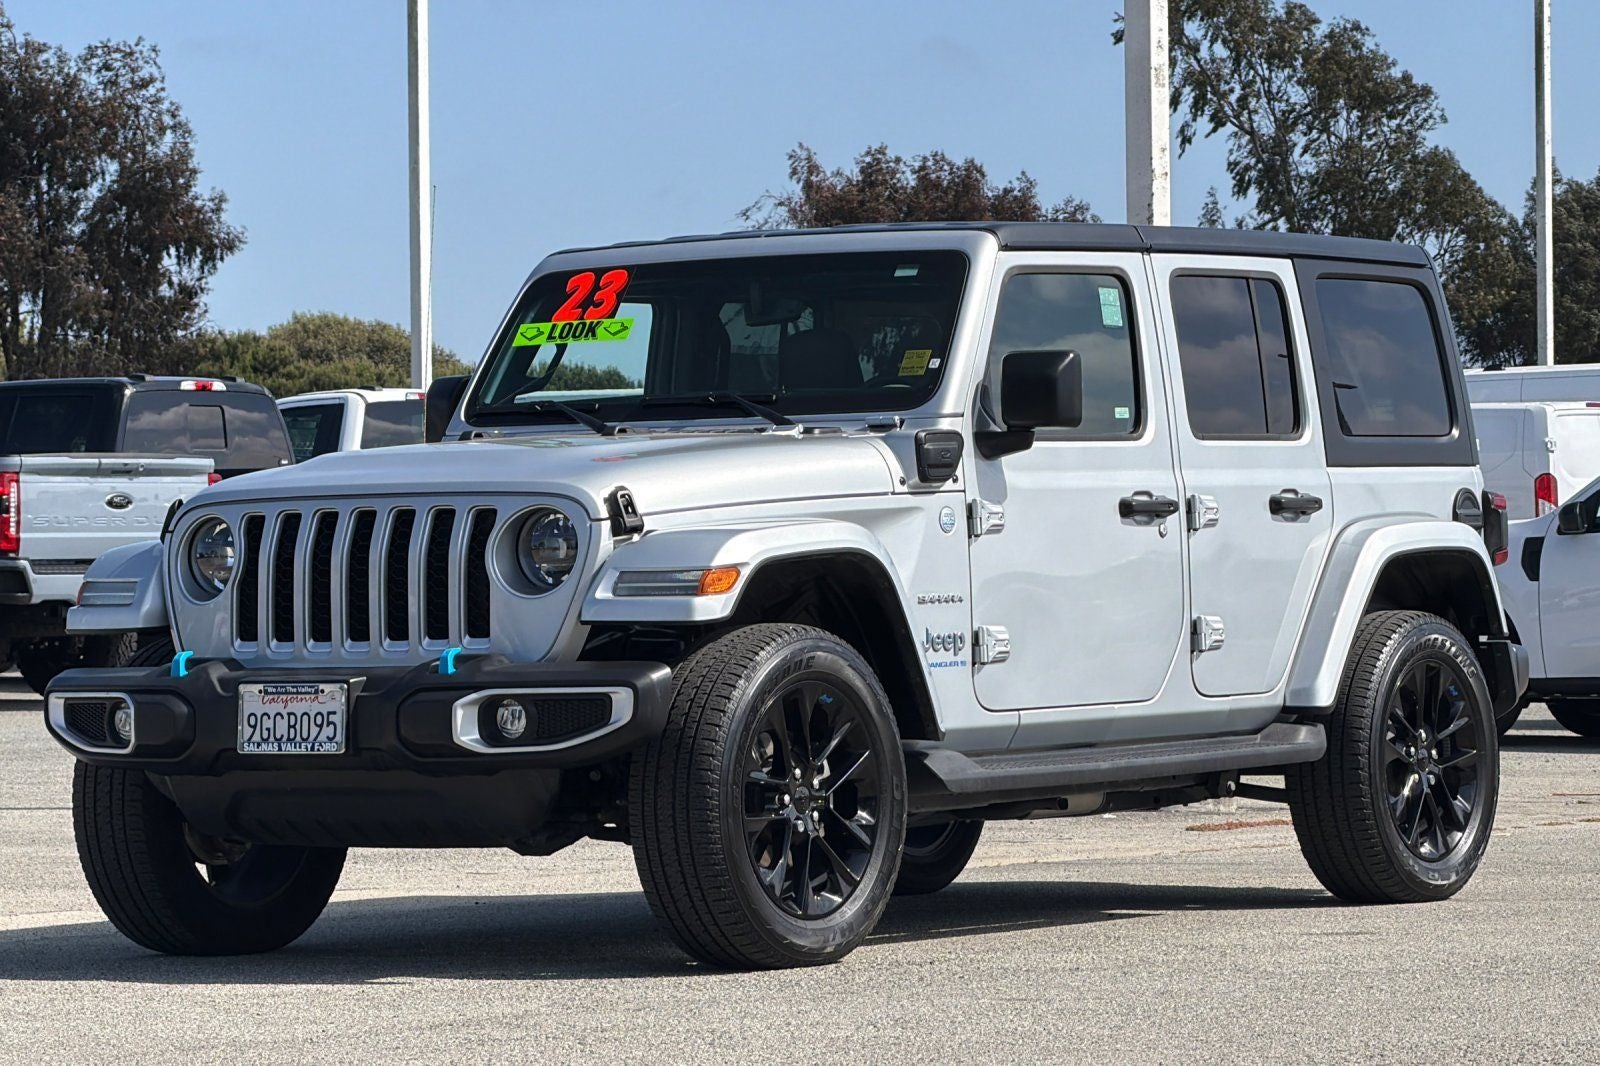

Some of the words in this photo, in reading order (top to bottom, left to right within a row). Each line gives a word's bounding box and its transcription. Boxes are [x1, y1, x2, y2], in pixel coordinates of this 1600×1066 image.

[551, 269, 629, 323] 23
[546, 320, 604, 342] LOOK
[32, 515, 128, 527] SUPER
[132, 515, 164, 527] DU
[922, 627, 966, 657] Jeep
[928, 660, 959, 669] ANGLER
[246, 711, 337, 742] 9GCB095
[243, 742, 279, 752] SALINAS
[281, 742, 312, 752] VALLEY
[314, 742, 338, 752] FORD
